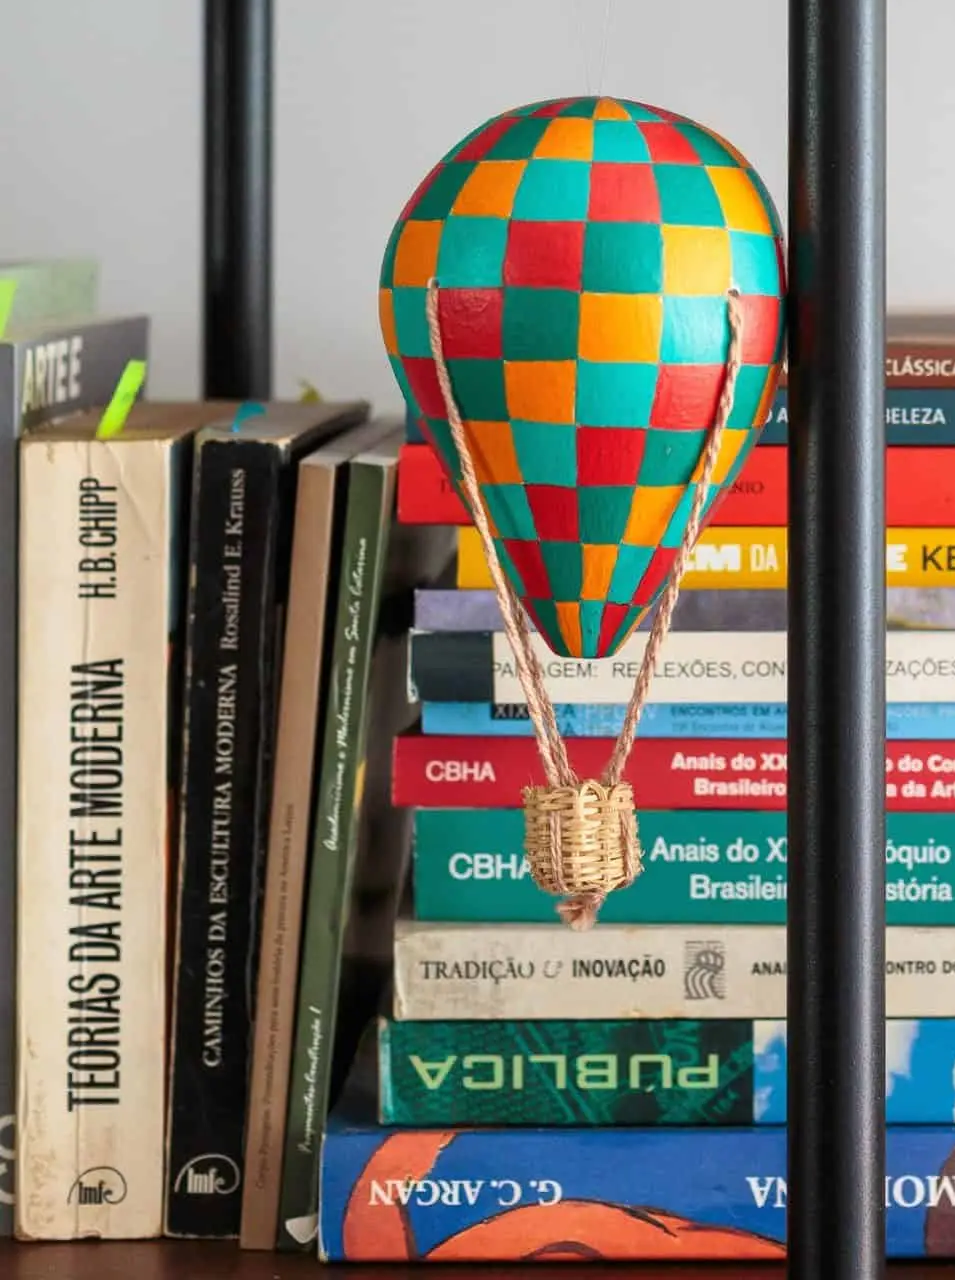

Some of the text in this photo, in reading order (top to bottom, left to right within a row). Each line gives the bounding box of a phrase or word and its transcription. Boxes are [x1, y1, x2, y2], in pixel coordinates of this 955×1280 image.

[225, 468, 244, 535] Krauss
[751, 545, 778, 572] DA
[220, 565, 240, 651] Rosalind
[611, 656, 736, 681] RELEXÕES,
[426, 761, 495, 781] CBHA
[672, 753, 726, 771] Anais
[731, 753, 756, 771] do
[898, 755, 923, 772] do
[694, 778, 787, 796] Brasileiro
[902, 781, 926, 797] da
[204, 664, 237, 1068] CAMINHOS DA ESCULTURA MODERNA
[650, 837, 719, 862] Anais
[729, 838, 759, 862] do
[885, 838, 950, 872] óquio
[68, 657, 124, 1112] TEORIAS DA ARTE MODERNA
[885, 876, 952, 903] stória
[420, 957, 534, 985] TRADIÇÃO
[573, 954, 665, 981] INOVAÇÃO
[885, 959, 936, 976] ONTRO
[409, 1054, 720, 1095] PÚBLICA
[367, 1178, 483, 1208] ARGAN
